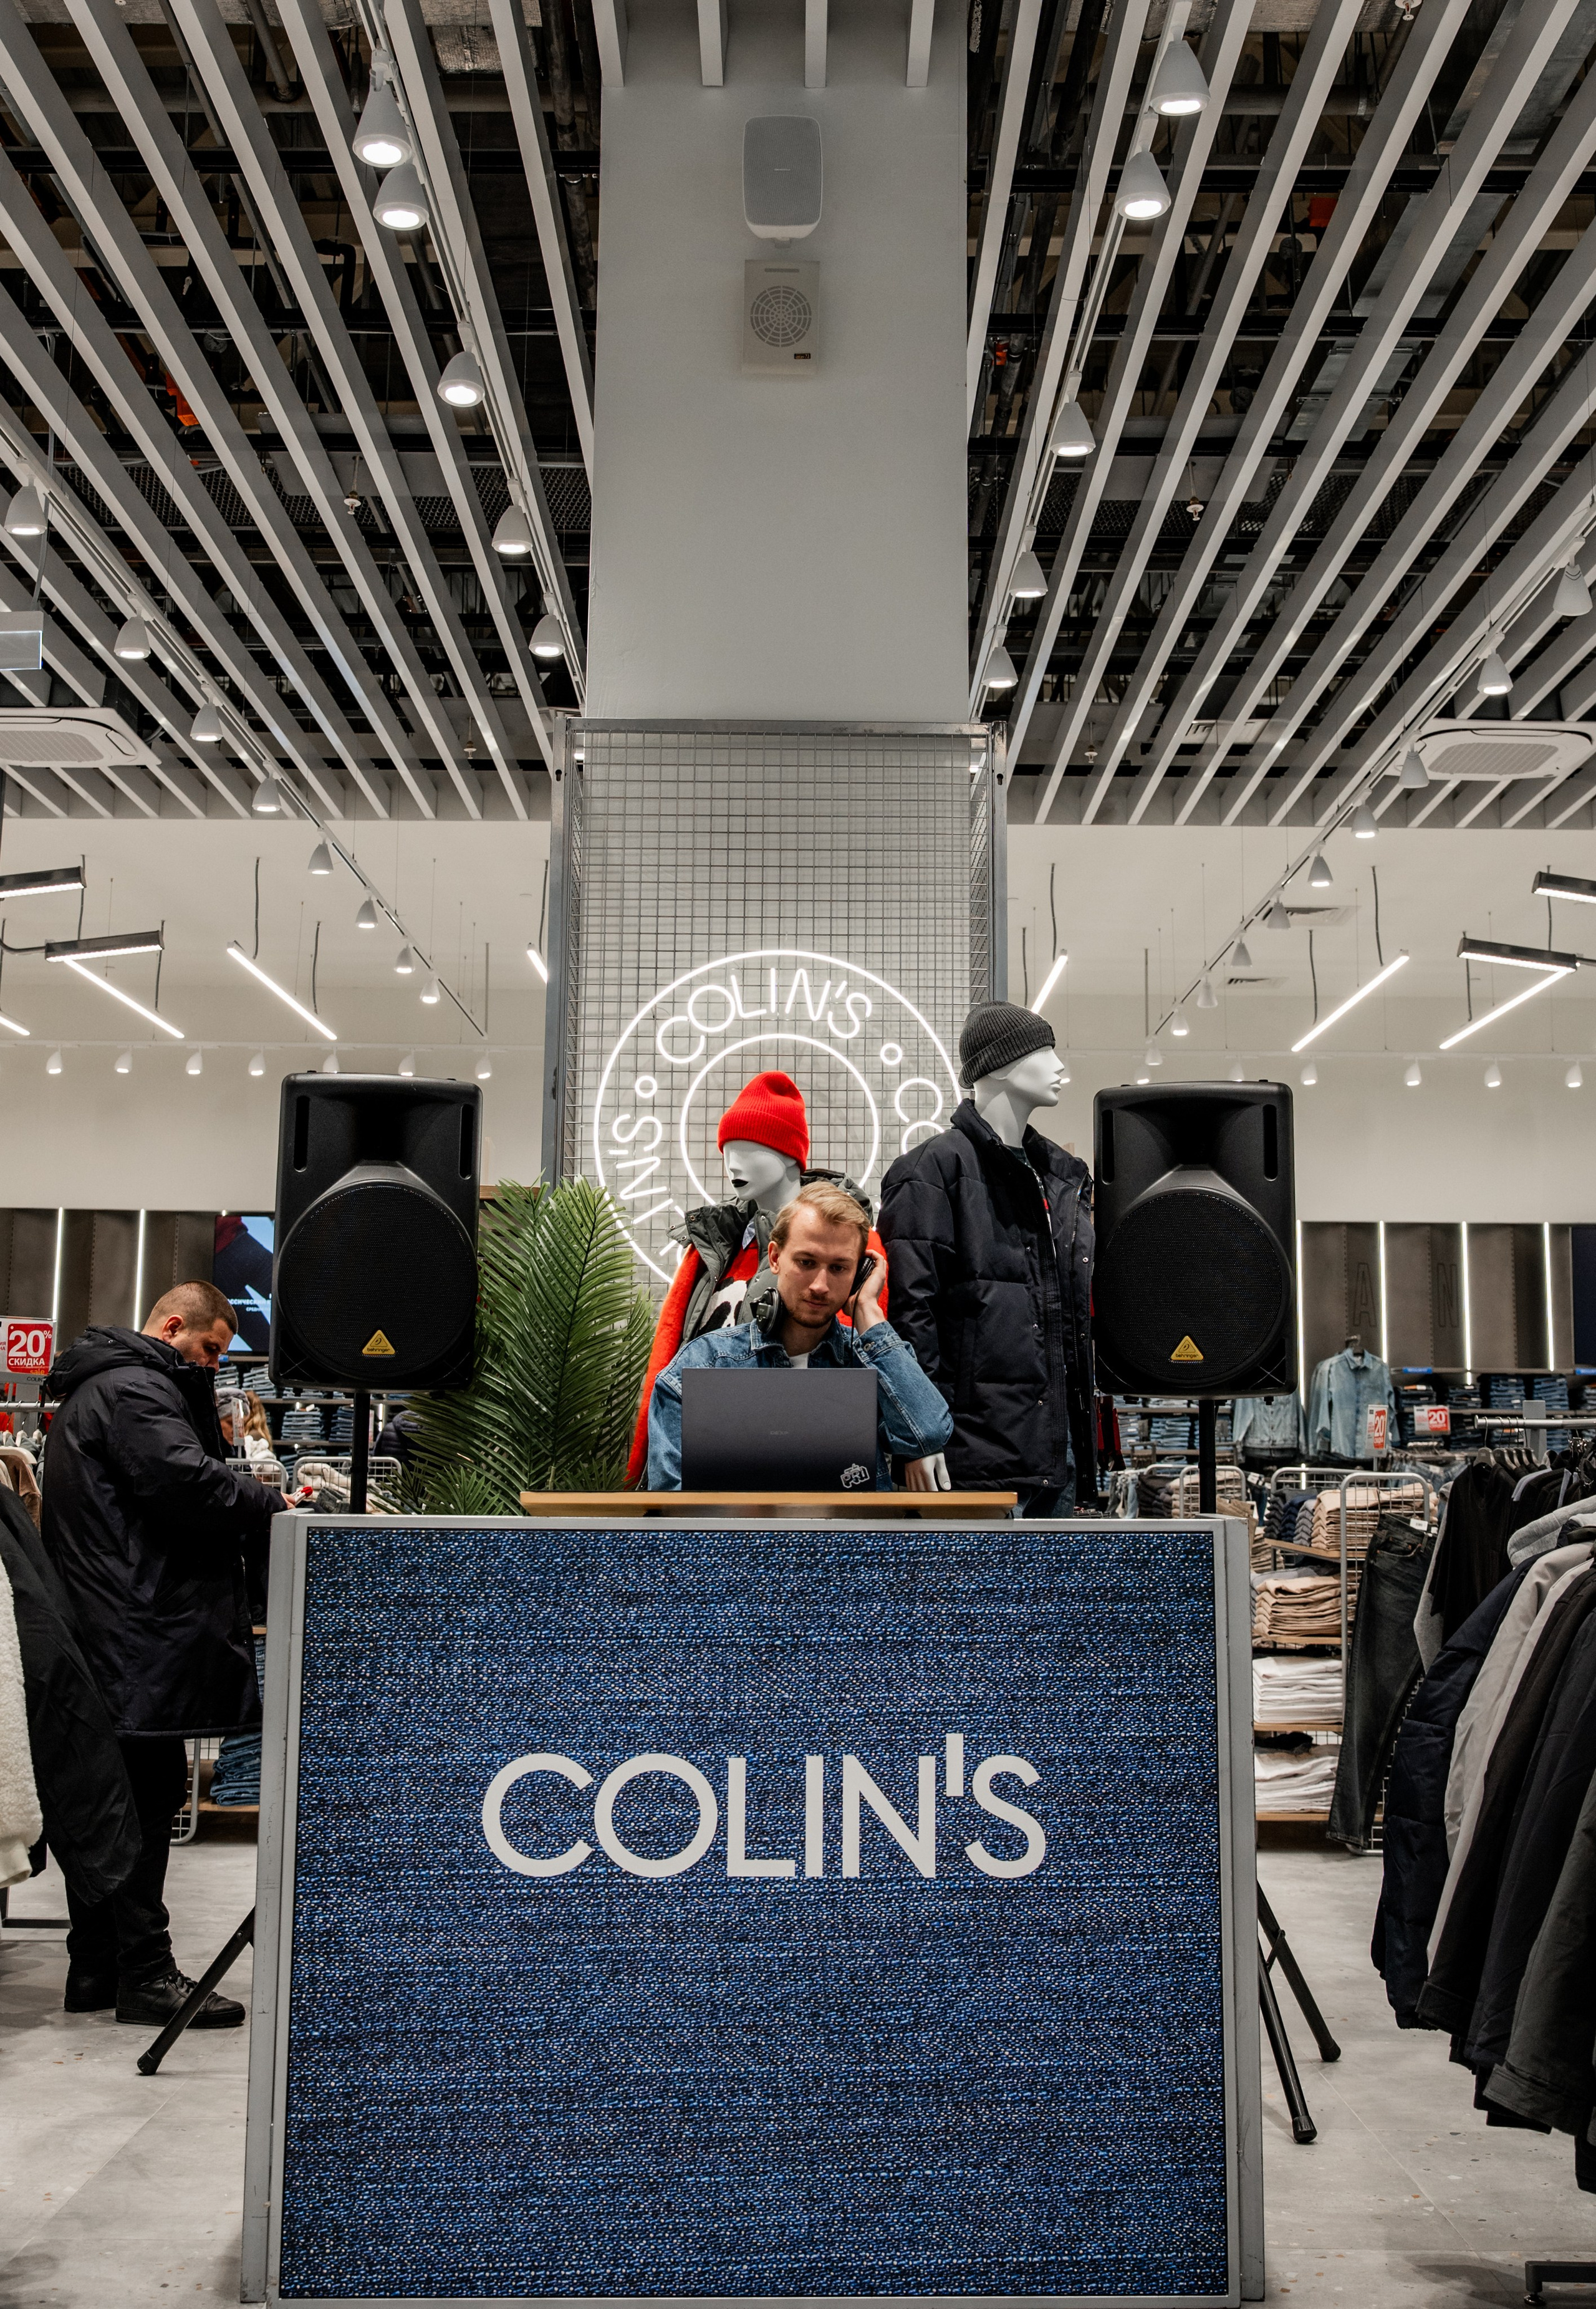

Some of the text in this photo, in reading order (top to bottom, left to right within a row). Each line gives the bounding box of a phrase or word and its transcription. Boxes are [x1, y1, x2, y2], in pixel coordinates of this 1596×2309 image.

[656, 968, 872, 1064] COLIN'S
[8, 1329, 52, 1357] 20%
[8, 1358, 45, 1367] СКИДКА
[1374, 1414, 1386, 1437] 20
[1428, 1410, 1448, 1424] 20
[482, 1733, 1046, 1878] COLIN'S
